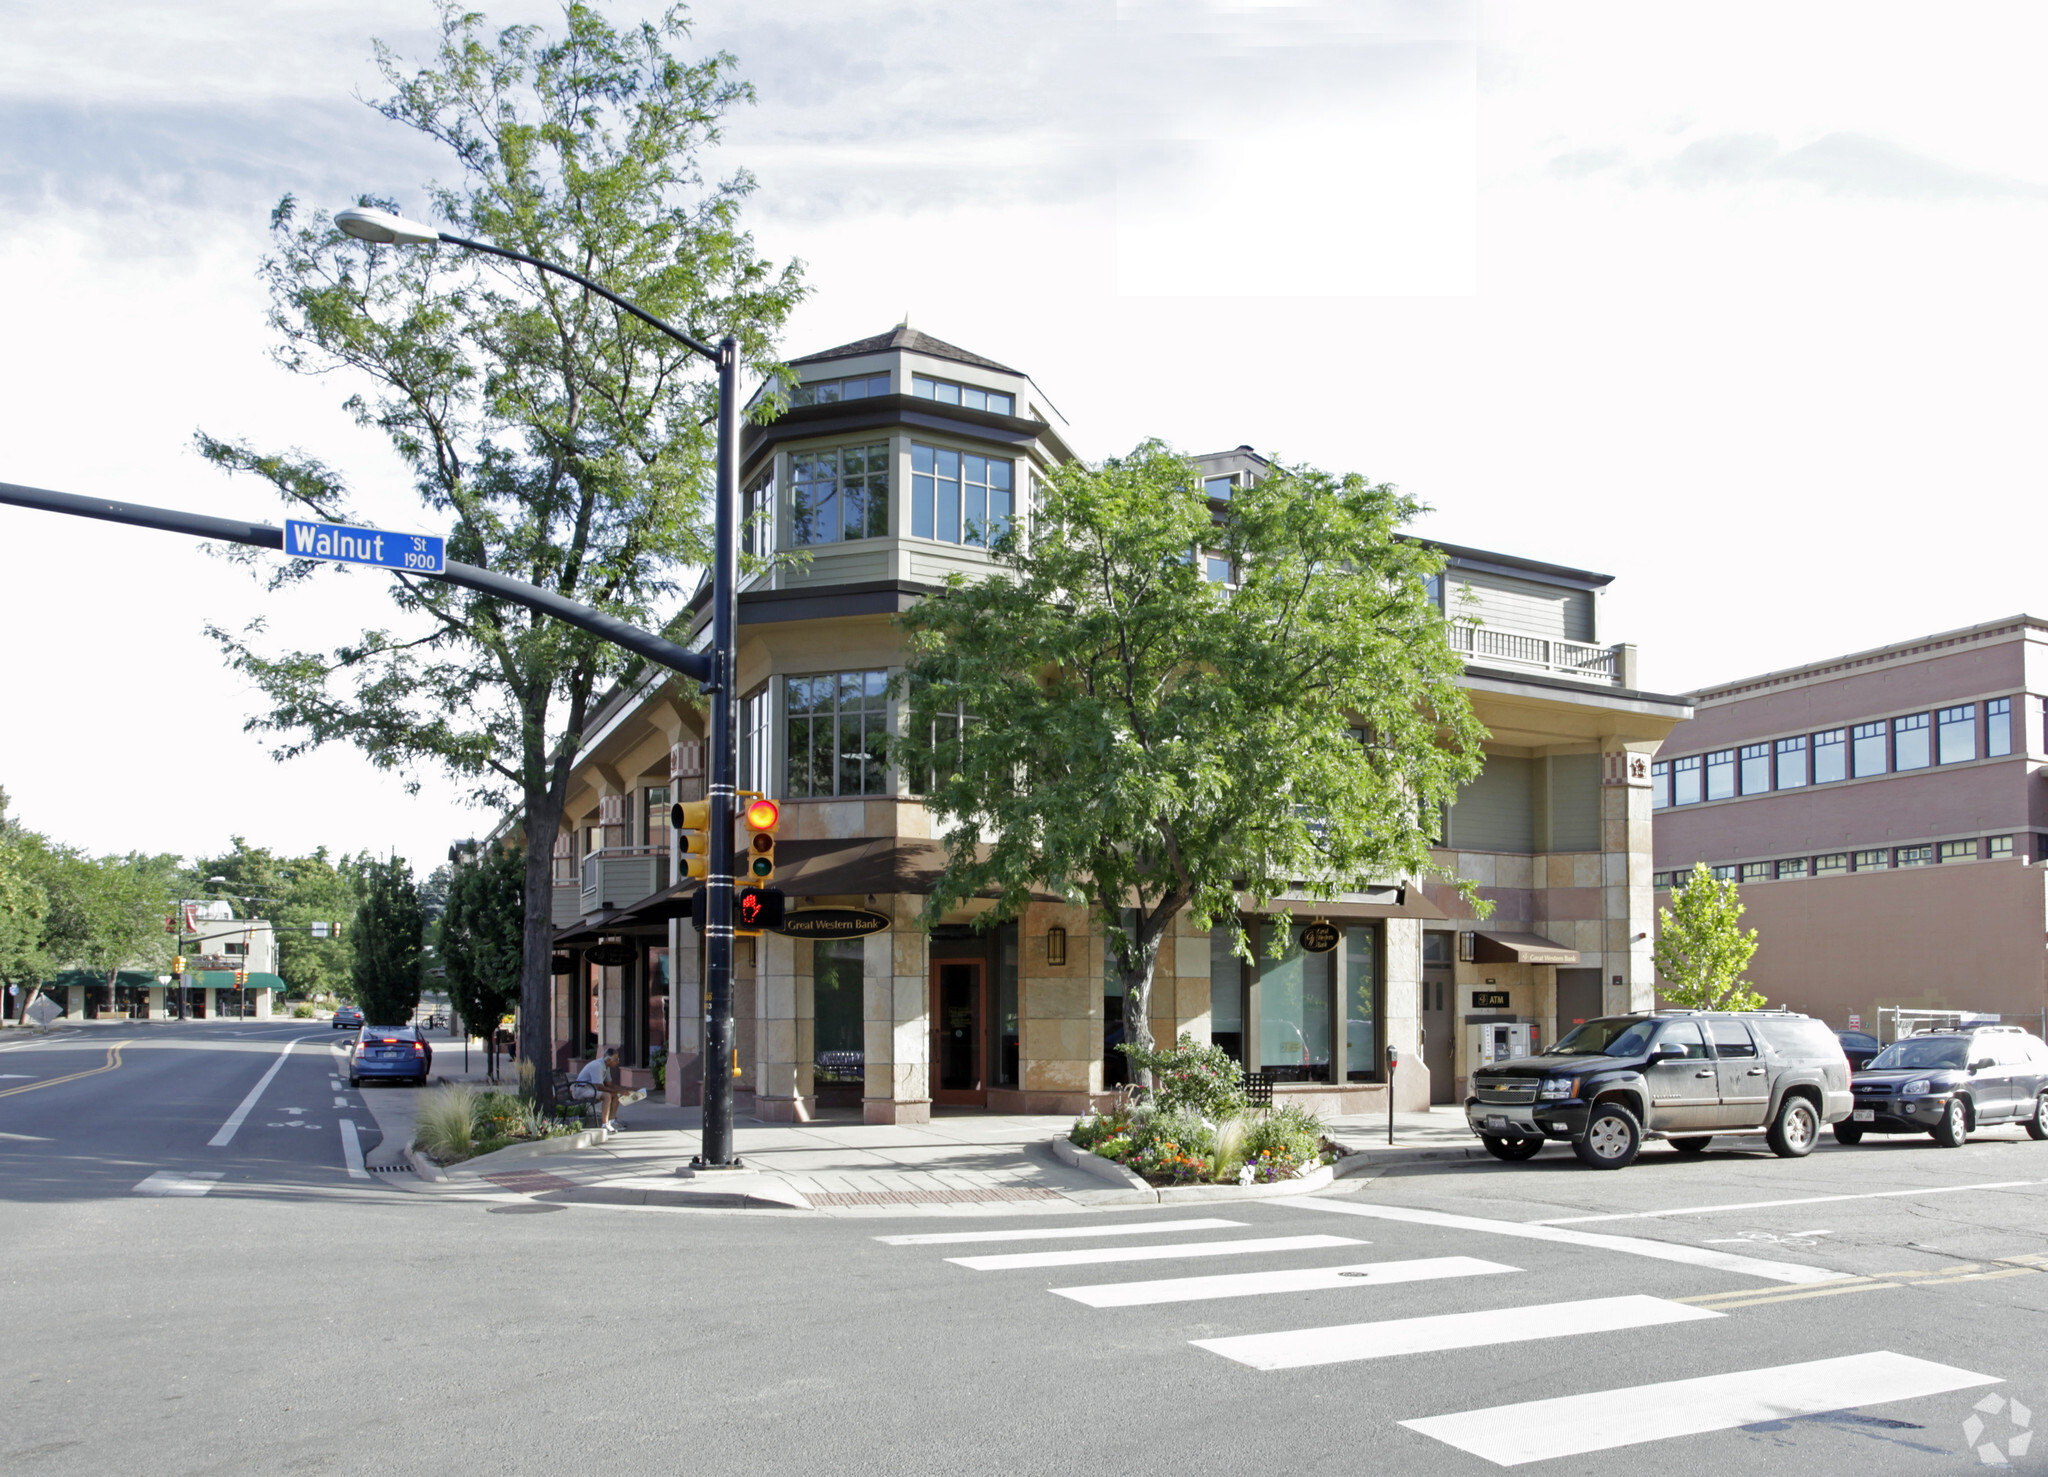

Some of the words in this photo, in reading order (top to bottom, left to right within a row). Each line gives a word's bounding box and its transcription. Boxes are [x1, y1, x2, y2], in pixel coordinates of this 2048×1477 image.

[294, 524, 385, 562] Walnut
[413, 537, 427, 552] St
[404, 552, 436, 569] 1900
[787, 920, 813, 930] Great
[815, 919, 853, 929] Western
[855, 918, 878, 929] Bank
[1564, 954, 1577, 962] Bank
[1489, 995, 1504, 1004] ATM
